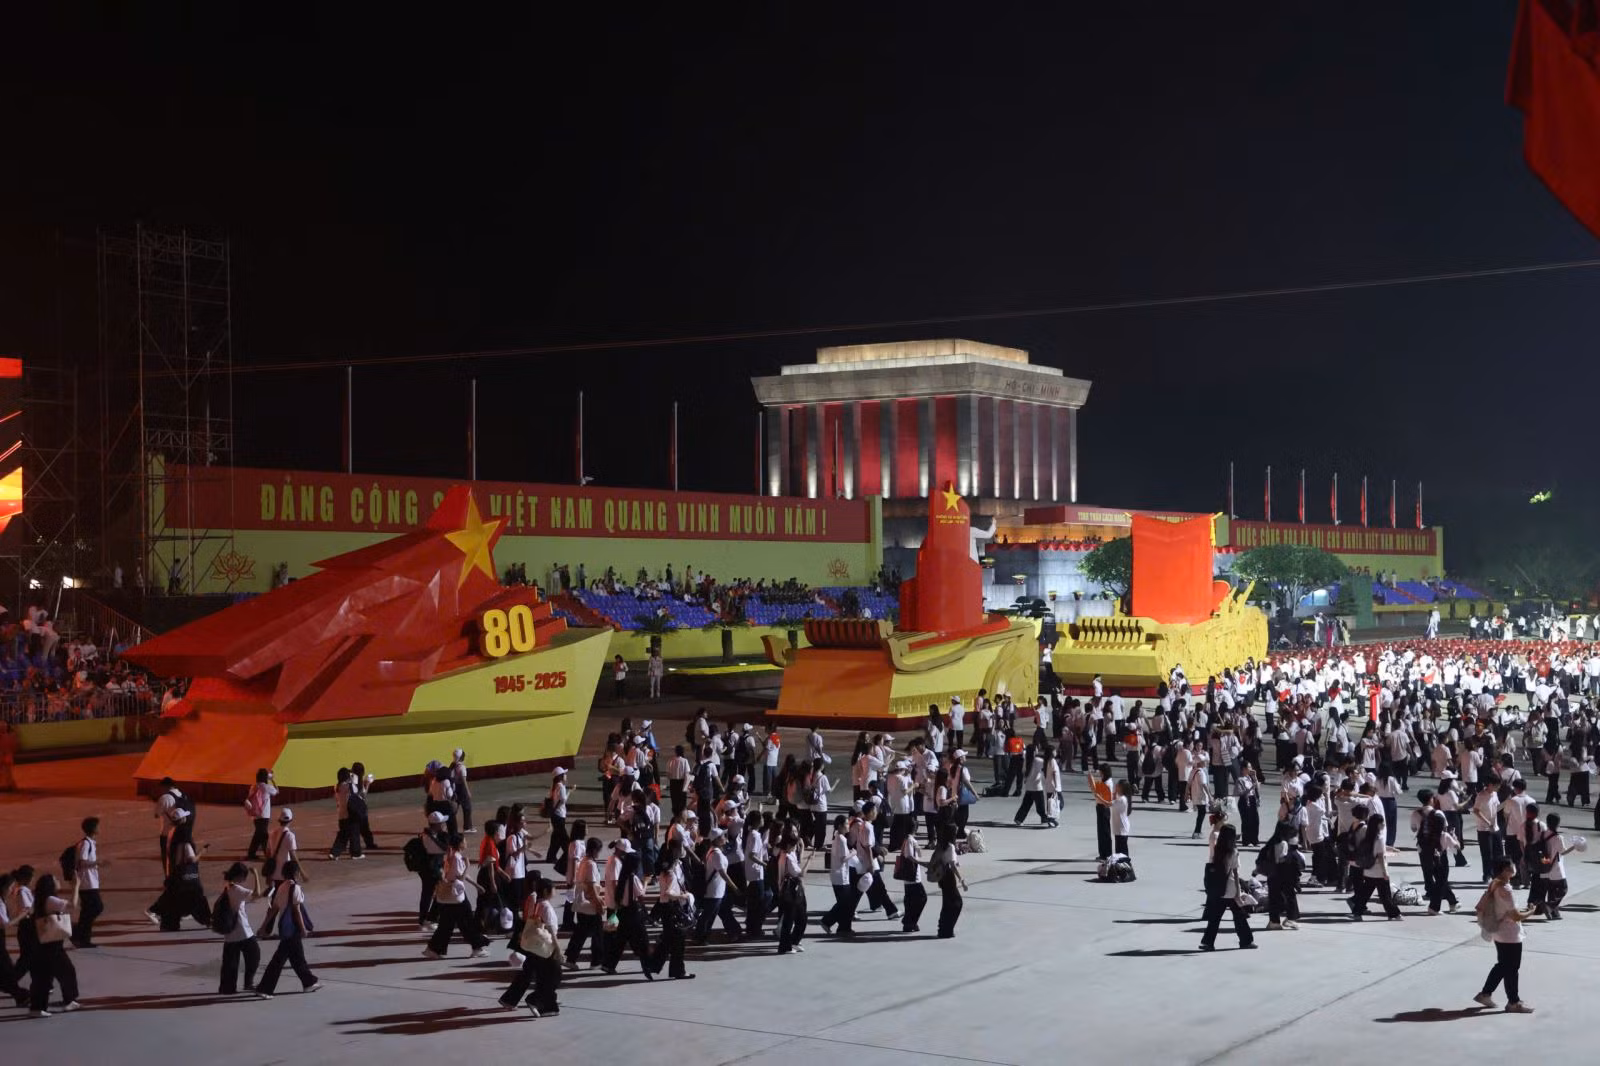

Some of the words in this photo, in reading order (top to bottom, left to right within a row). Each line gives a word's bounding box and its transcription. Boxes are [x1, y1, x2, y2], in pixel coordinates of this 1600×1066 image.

[260, 475, 335, 522] ĐẢNG
[350, 482, 419, 530] CỘNG
[489, 489, 538, 533] VIỆT
[550, 497, 593, 529] NAM
[604, 499, 668, 533] QUANG
[677, 502, 720, 533] VINH
[729, 502, 776, 534] MUÔN
[483, 604, 536, 657] 80
